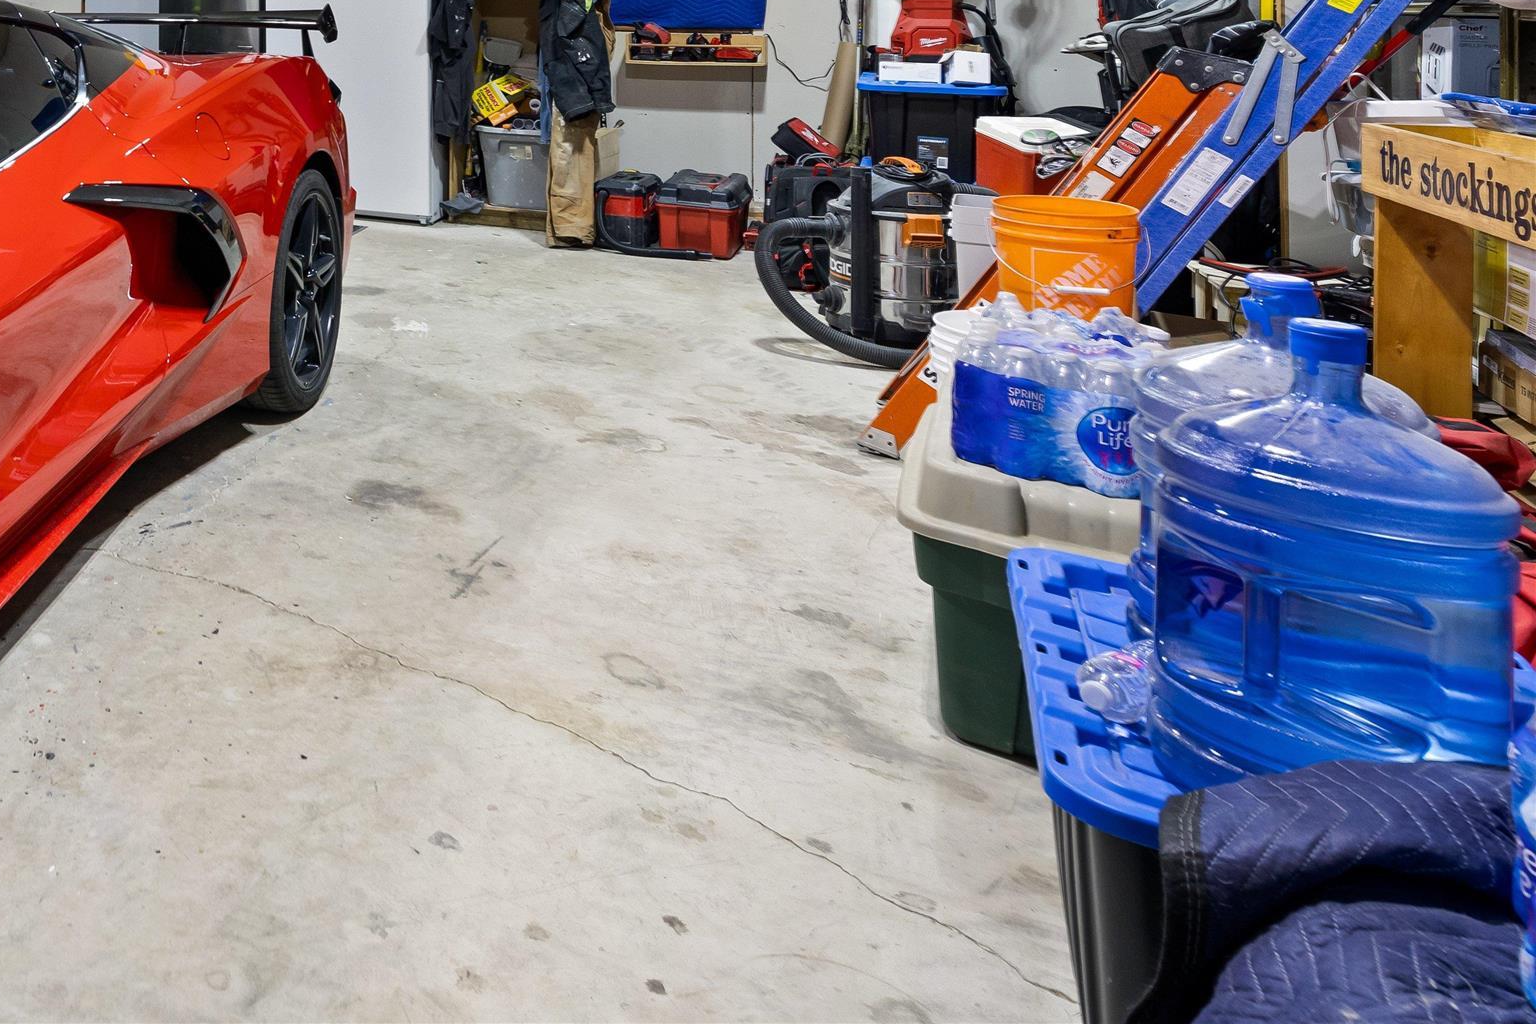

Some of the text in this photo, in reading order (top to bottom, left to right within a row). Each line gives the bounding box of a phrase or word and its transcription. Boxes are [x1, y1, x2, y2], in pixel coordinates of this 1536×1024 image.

[483, 85, 500, 107] HUSKY
[1380, 140, 1412, 189] the
[1008, 387, 1045, 403] SPRING
[1009, 397, 1044, 413] WATER
[1091, 414, 1130, 432] Pur
